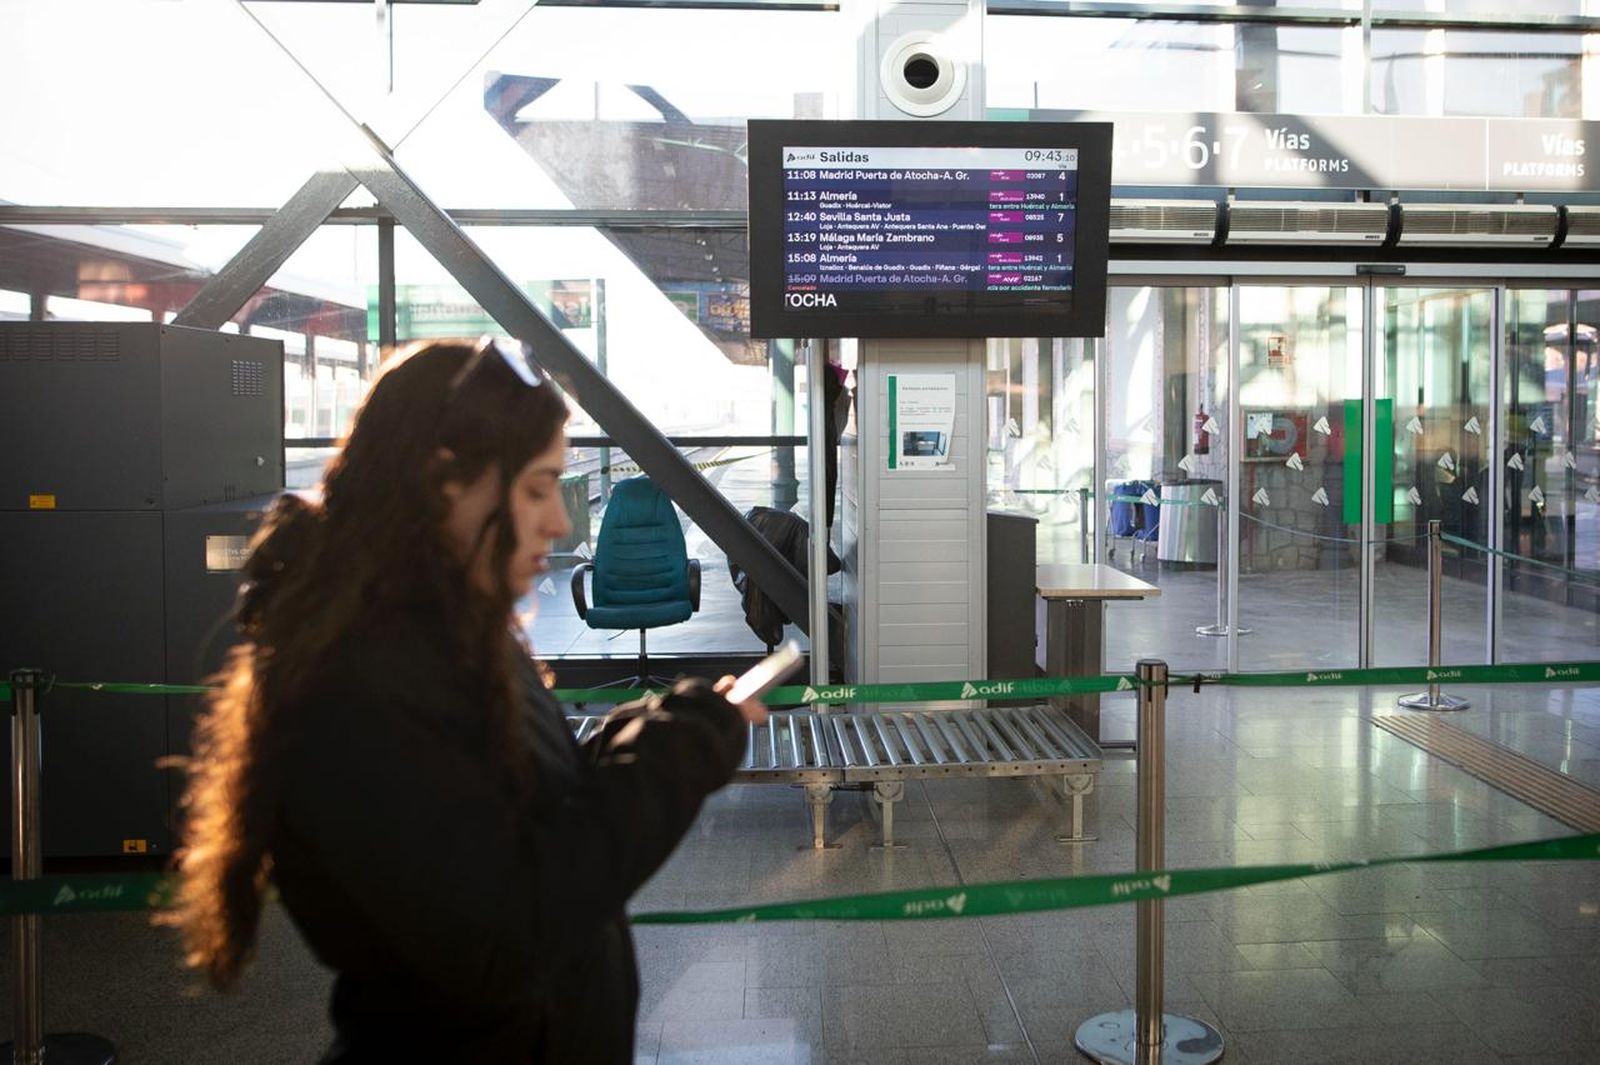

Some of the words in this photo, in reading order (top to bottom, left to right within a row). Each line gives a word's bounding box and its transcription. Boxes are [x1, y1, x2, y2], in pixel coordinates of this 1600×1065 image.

[1265, 127, 1310, 150] Vías
[1542, 133, 1585, 156] Vías
[820, 151, 869, 162] Salidas
[1025, 150, 1061, 161] 09:43
[1264, 158, 1349, 172] PLATFORMS
[1503, 161, 1585, 177] PLATFORMS
[787, 170, 816, 180] 11:08
[820, 170, 854, 180] Madrid
[856, 171, 887, 180] Puerta
[890, 171, 902, 180] de
[904, 171, 953, 180] Atocha-A.
[955, 171, 970, 180] Gr.
[1059, 171, 1066, 180] 4
[787, 191, 816, 200] 11:13
[820, 191, 857, 201] Almería
[1060, 192, 1064, 201] 1
[787, 212, 816, 221] 12:40
[820, 212, 852, 221] Sevilla
[854, 212, 882, 221] Santa
[884, 212, 911, 221] Justa
[1058, 213, 1064, 222] 7
[819, 223, 832, 231] Loja
[837, 223, 869, 231] Antequera
[884, 223, 916, 231] Antequera
[787, 232, 816, 242] 13:19
[820, 232, 855, 244] Málaga
[857, 232, 884, 242] María
[886, 233, 935, 242] Zambrano
[1057, 233, 1064, 242] 5
[787, 253, 816, 263] 15:08
[820, 253, 857, 263] Almería
[1057, 254, 1062, 263] 1
[820, 273, 853, 283] Madrid
[856, 274, 887, 283] Puerta
[889, 274, 901, 283] de
[953, 274, 968, 284] Gr.
[820, 687, 857, 699] adif
[979, 682, 1014, 695] adif
